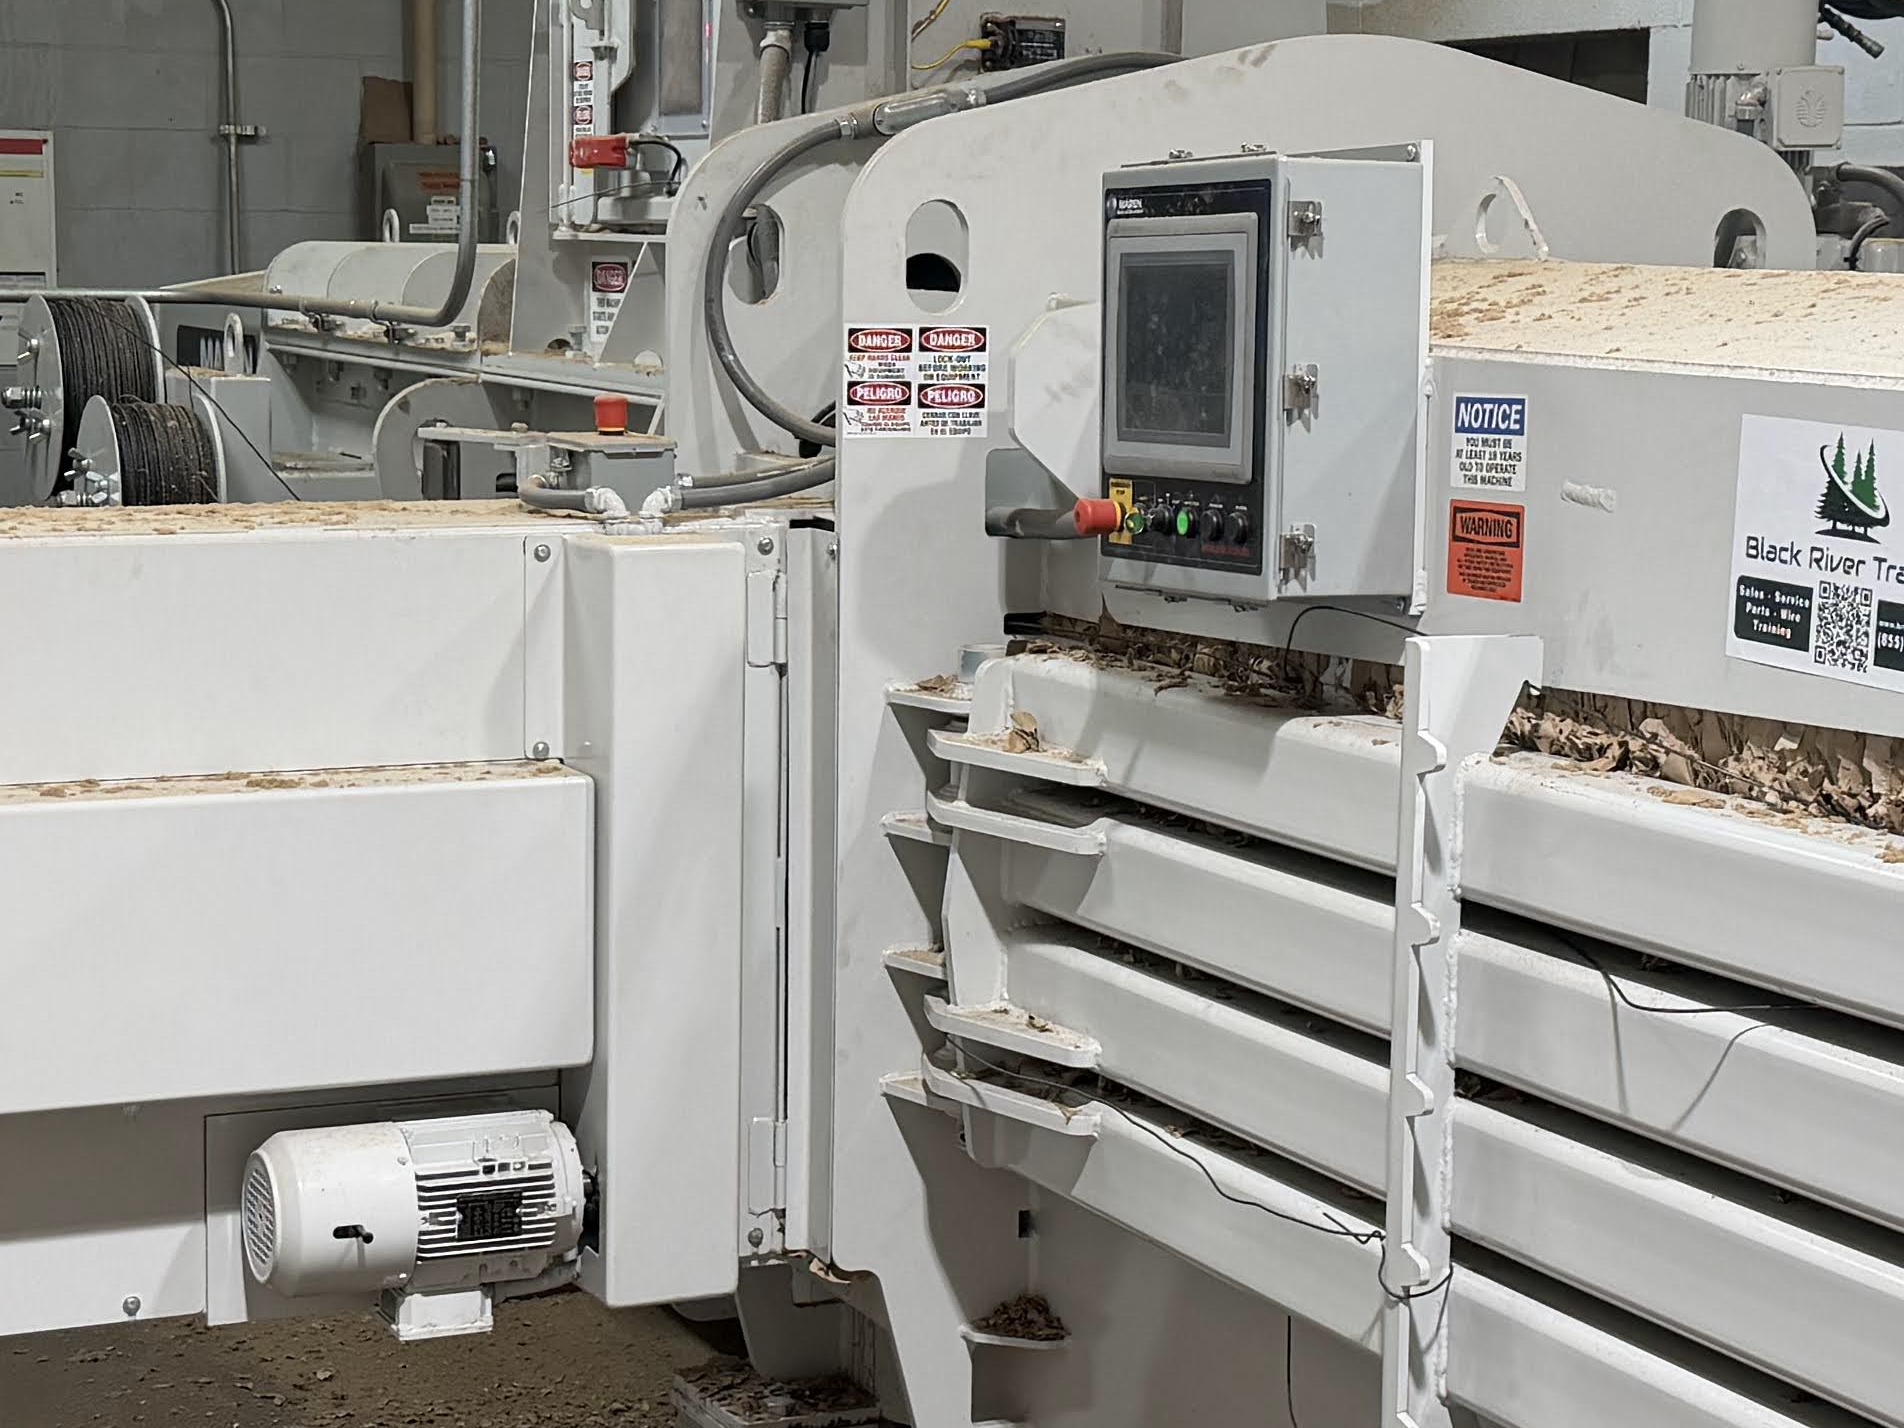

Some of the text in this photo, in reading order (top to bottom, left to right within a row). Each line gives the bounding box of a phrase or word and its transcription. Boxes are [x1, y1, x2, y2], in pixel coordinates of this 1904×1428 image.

[859, 335, 901, 347] DANGER
[929, 333, 975, 346] DANGER
[857, 387, 902, 399] PELIGRO
[927, 390, 976, 403] PELIGRO
[1457, 403, 1523, 430] NOTICE
[1466, 437, 1512, 449] YOU MUST BE
[1456, 449, 1522, 462] AT LEAST 18 YEARS
[1459, 461, 1517, 475] OLD TO OPERATE
[1463, 474, 1512, 487] THIS MACHINE
[1459, 515, 1513, 539] WARNING
[1745, 535, 1802, 568] Black
[1809, 546, 1866, 577] River
[1739, 584, 1810, 608] Sales Service
[1745, 601, 1801, 623] Parts Wire
[1753, 619, 1792, 639] Training
[1877, 632, 1904, 652] (855)
